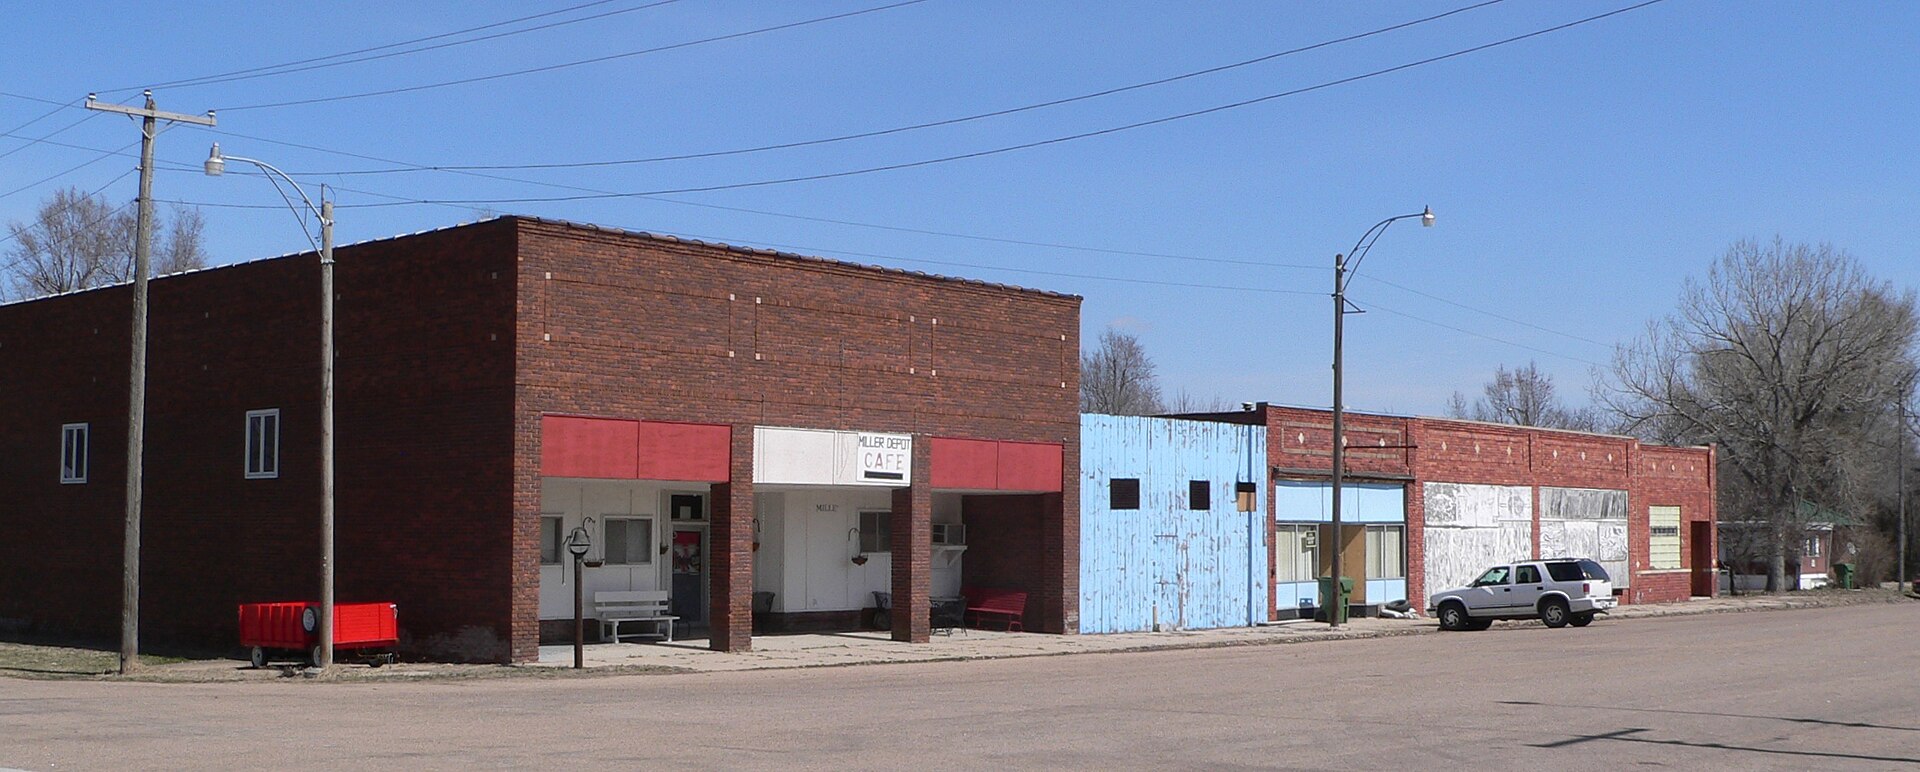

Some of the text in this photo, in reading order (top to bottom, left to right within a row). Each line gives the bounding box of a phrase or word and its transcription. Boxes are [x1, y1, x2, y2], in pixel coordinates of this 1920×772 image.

[858, 436, 911, 450] MILLER DEPOT
[864, 452, 904, 470] CAFE
